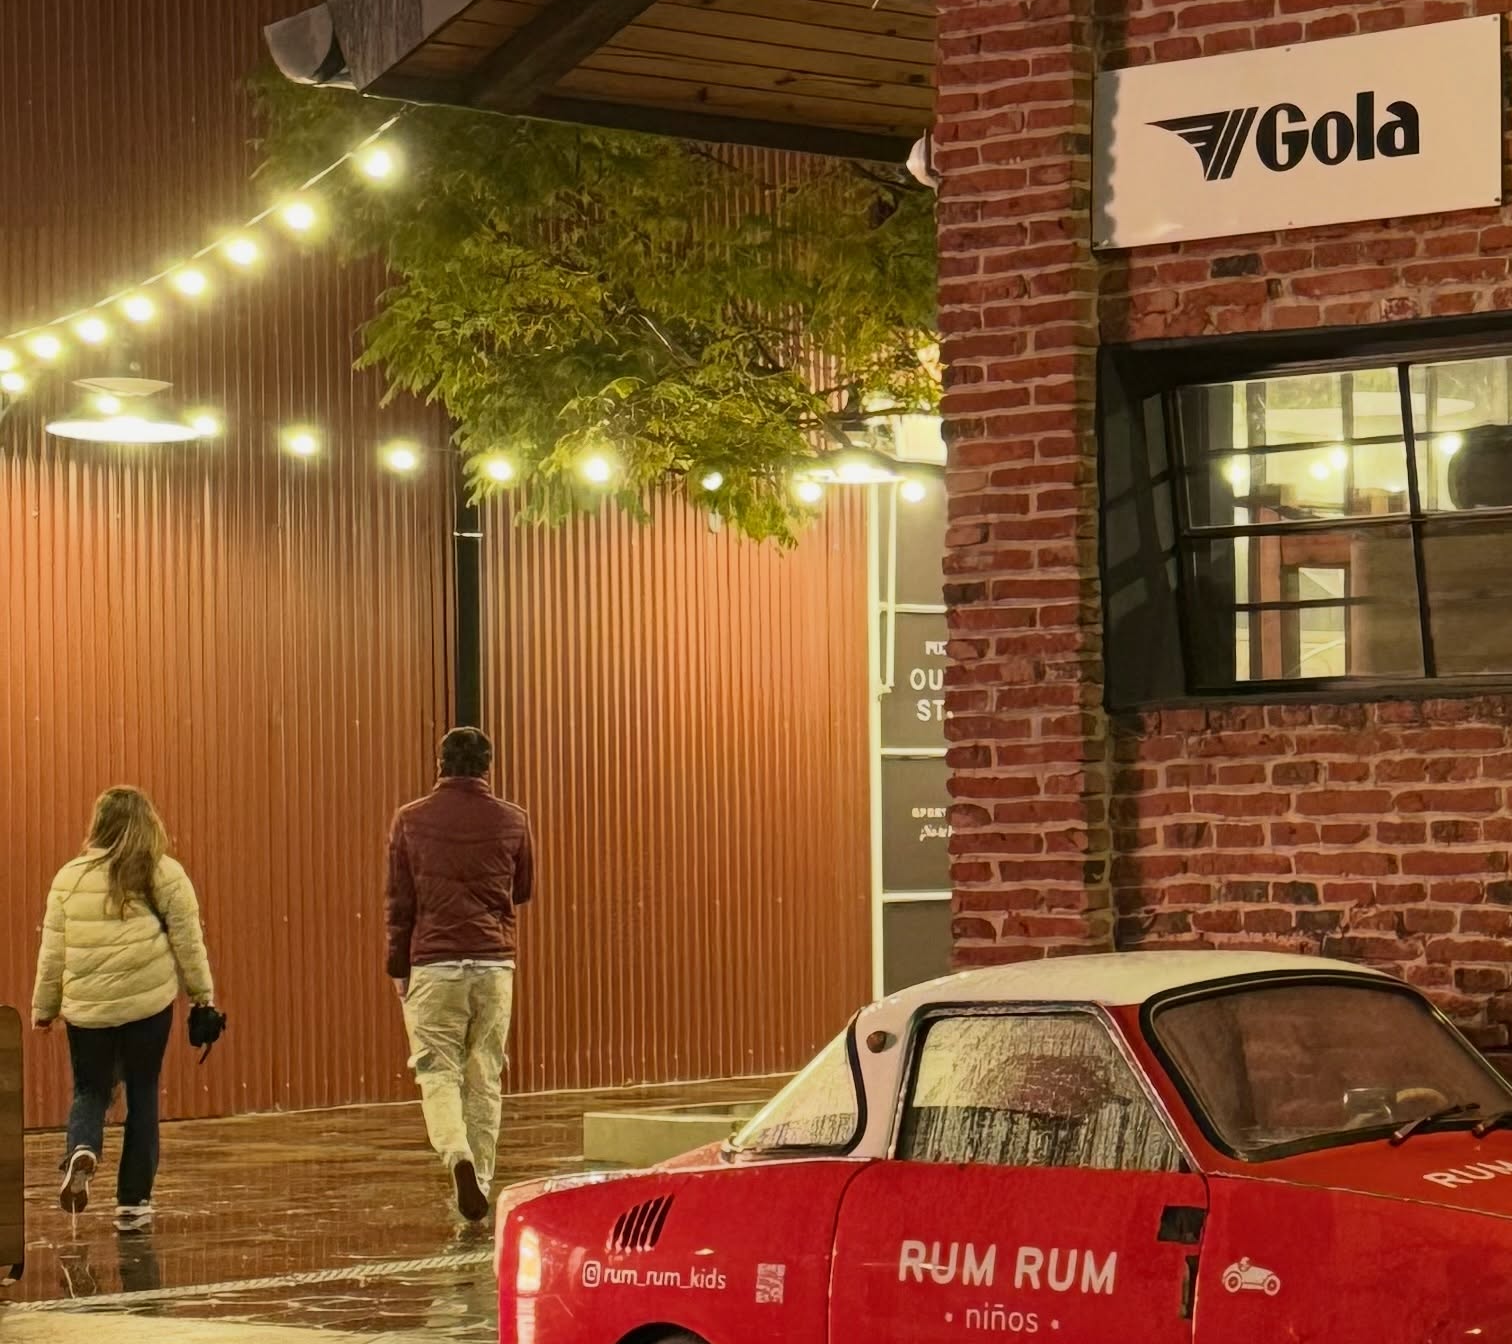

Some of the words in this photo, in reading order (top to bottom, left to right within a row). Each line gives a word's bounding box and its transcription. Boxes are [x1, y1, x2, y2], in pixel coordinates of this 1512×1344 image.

[1255, 90, 1420, 173] Gola
[909, 667, 944, 692] OU
[916, 698, 954, 722] ST
[899, 1240, 997, 1287] RUM
[1014, 1246, 1117, 1295] RUM
[965, 1302, 1039, 1334] niños
